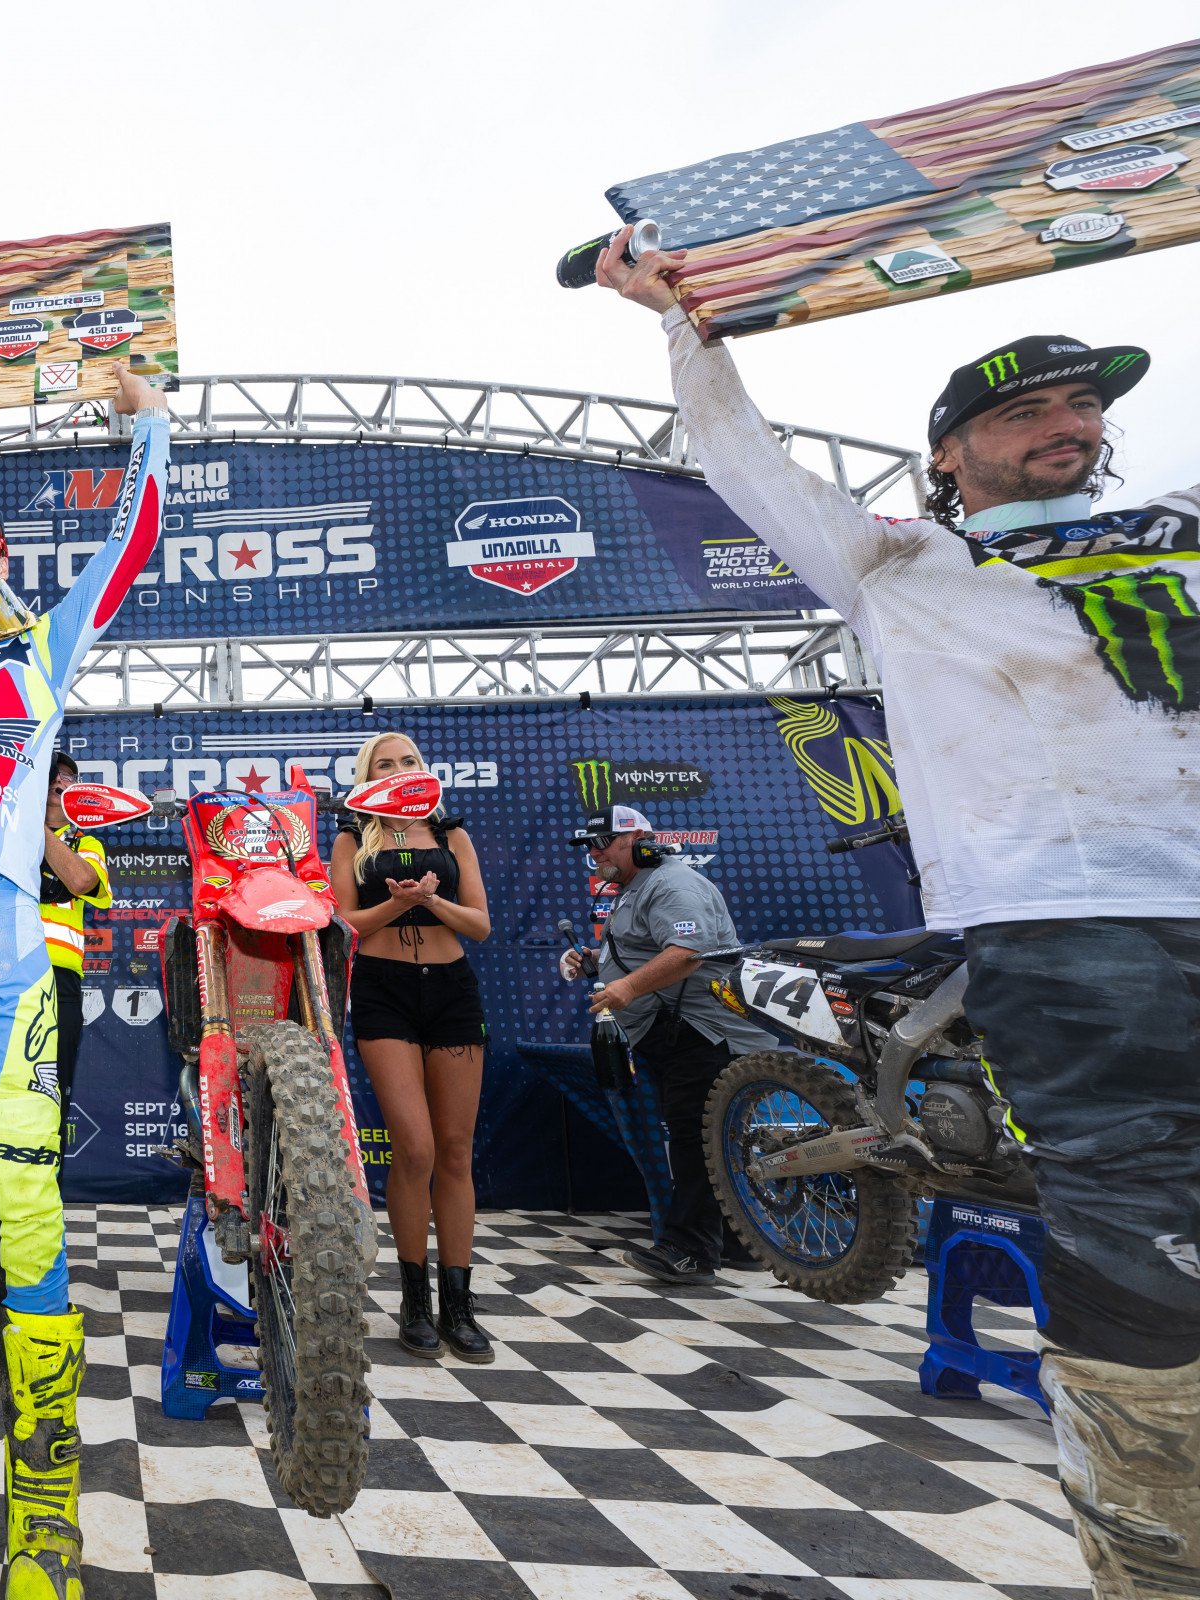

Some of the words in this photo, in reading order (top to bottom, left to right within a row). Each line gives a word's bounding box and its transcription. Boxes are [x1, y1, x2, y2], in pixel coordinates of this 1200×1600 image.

[1071, 111, 1200, 146] MOTOCRO
[1077, 150, 1152, 169] HONDA
[1080, 160, 1156, 181] UNADILLA
[1040, 213, 1125, 243] EKLUND
[891, 261, 953, 279] Anderson
[11, 295, 102, 310] MOTOCROSS
[99, 311, 115, 324] 1st
[87, 326, 108, 335] 450
[93, 335, 118, 343] 2023
[1018, 361, 1099, 387] YAMAHA
[112, 442, 147, 541] HONDA
[488, 513, 572, 529] HONDA
[481, 538, 562, 559] UNADILLA
[703, 545, 772, 559] SUPER
[483, 561, 565, 573] NATIONAL
[709, 555, 770, 568] MOTO
[706, 566, 771, 578] CROSS
[711, 581, 751, 590] WORLD
[69, 735, 193, 754] PRO
[388, 773, 434, 785] HONDA
[424, 761, 499, 788] 023
[614, 770, 702, 785] MONSTER
[69, 785, 111, 794] HONDA
[204, 795, 247, 804] HONDA
[400, 802, 430, 813] CYCRA
[76, 814, 104, 822] CYCRA
[250, 846, 263, 854] 18
[106, 853, 191, 869] MONSTER
[110, 898, 165, 909] MX-ATV
[258, 912, 316, 923] HONDA
[796, 940, 827, 948] YAMAHA
[751, 969, 820, 1020] 14
[124, 1102, 164, 1116] SEPT
[170, 1102, 181, 1116] 9
[124, 1123, 165, 1137] SEPT
[169, 1123, 188, 1137] 16
[199, 1074, 217, 1183] DUNLOP
[952, 1210, 1021, 1232] MOTOCROSS
